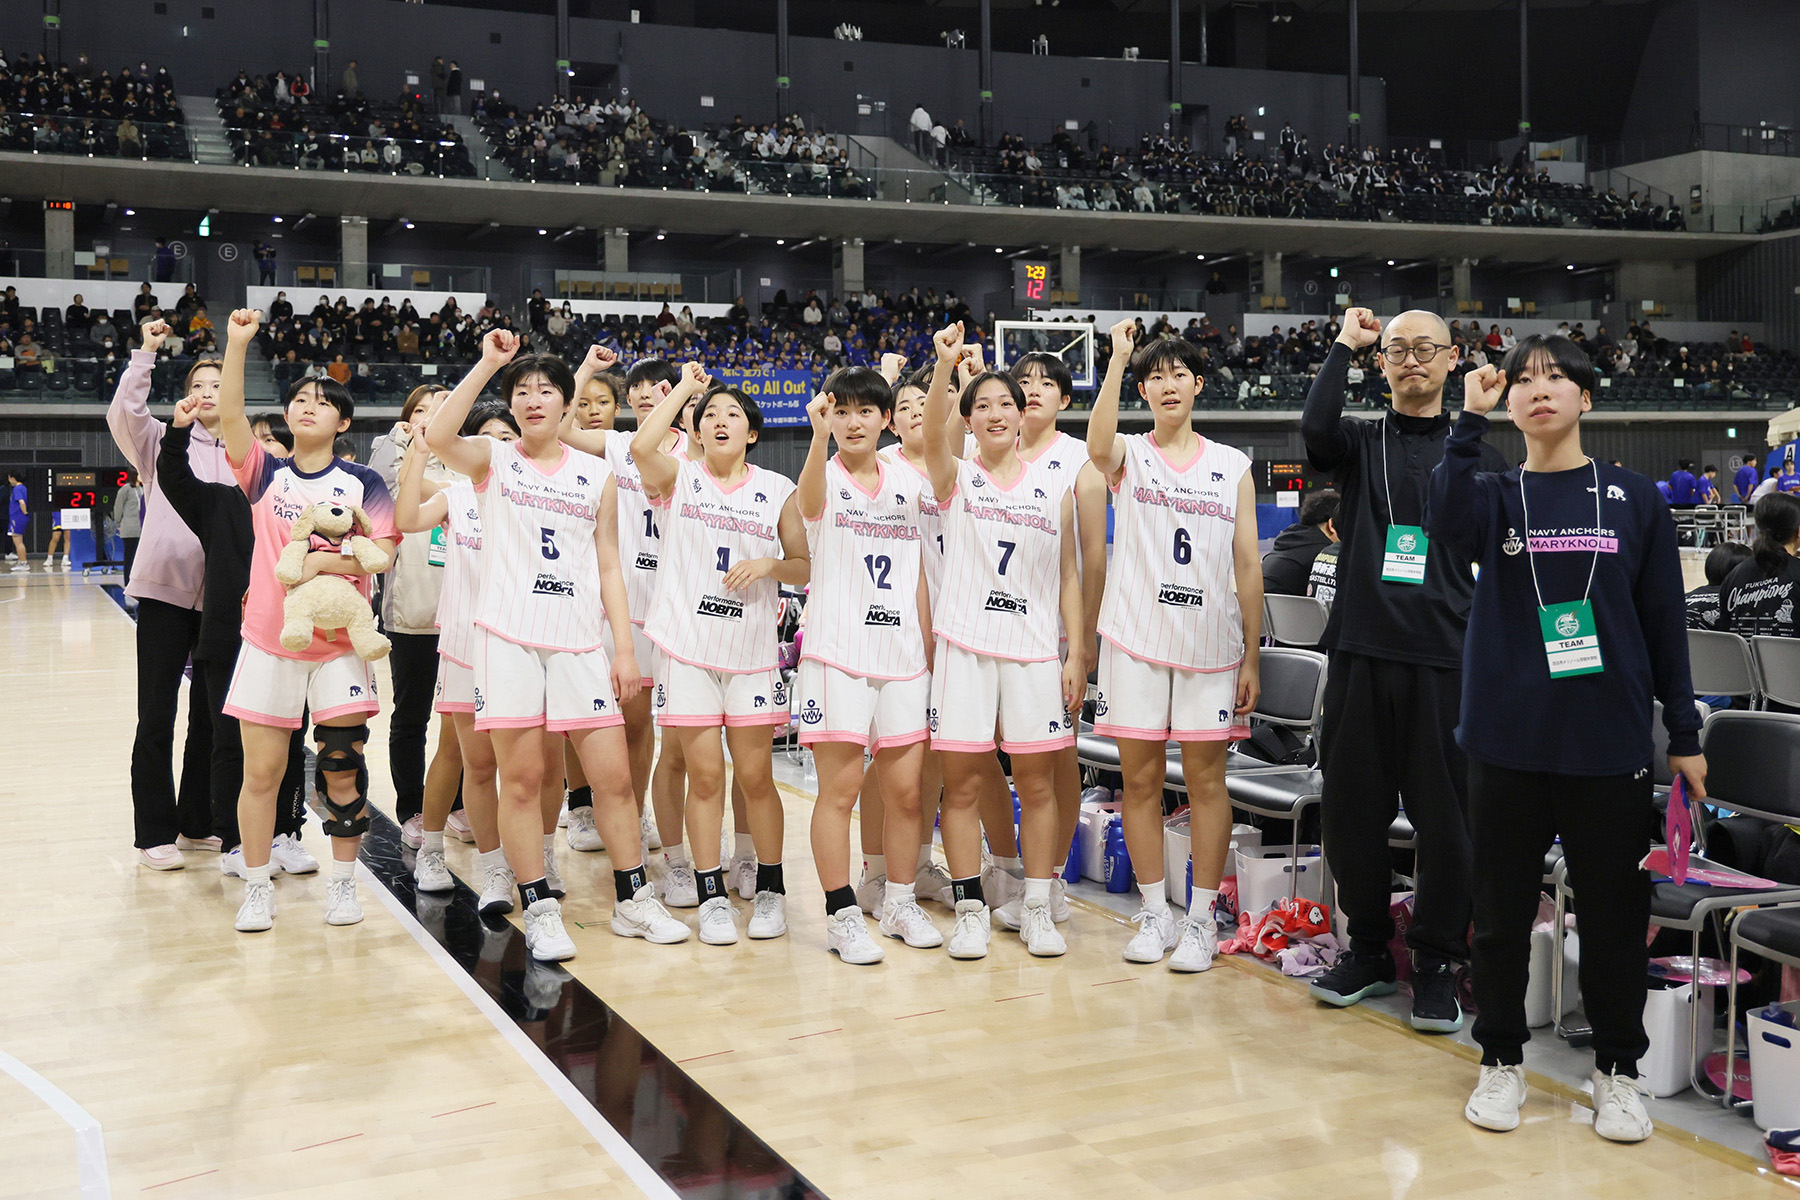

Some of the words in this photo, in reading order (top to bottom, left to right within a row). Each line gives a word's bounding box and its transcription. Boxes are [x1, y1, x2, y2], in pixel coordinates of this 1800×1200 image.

[1025, 265, 1046, 279] 7:23
[1026, 279, 1044, 299] 12
[742, 380, 760, 395] Go
[763, 380, 780, 395] All
[783, 380, 806, 394] Out
[1288, 478, 1303, 490] 17
[70, 492, 95, 507] 27
[543, 486, 586, 499] ANHORS
[835, 512, 921, 540] MRYKNOLL
[1560, 527, 1615, 537] ANCHORS
[540, 527, 560, 560] 5
[1173, 527, 1192, 565] 6
[1529, 538, 1615, 550] MARYKNOLL
[998, 540, 1016, 576] 7
[863, 554, 892, 590] 12
[1160, 582, 1204, 594] performance
[1745, 577, 1778, 590] FUKUOKA
[702, 593, 744, 607] performance
[1158, 588, 1203, 606] NOBITA
[1727, 581, 1793, 612] Champions
[698, 600, 743, 618] NOBITA
[1559, 639, 1584, 649] TEAM
